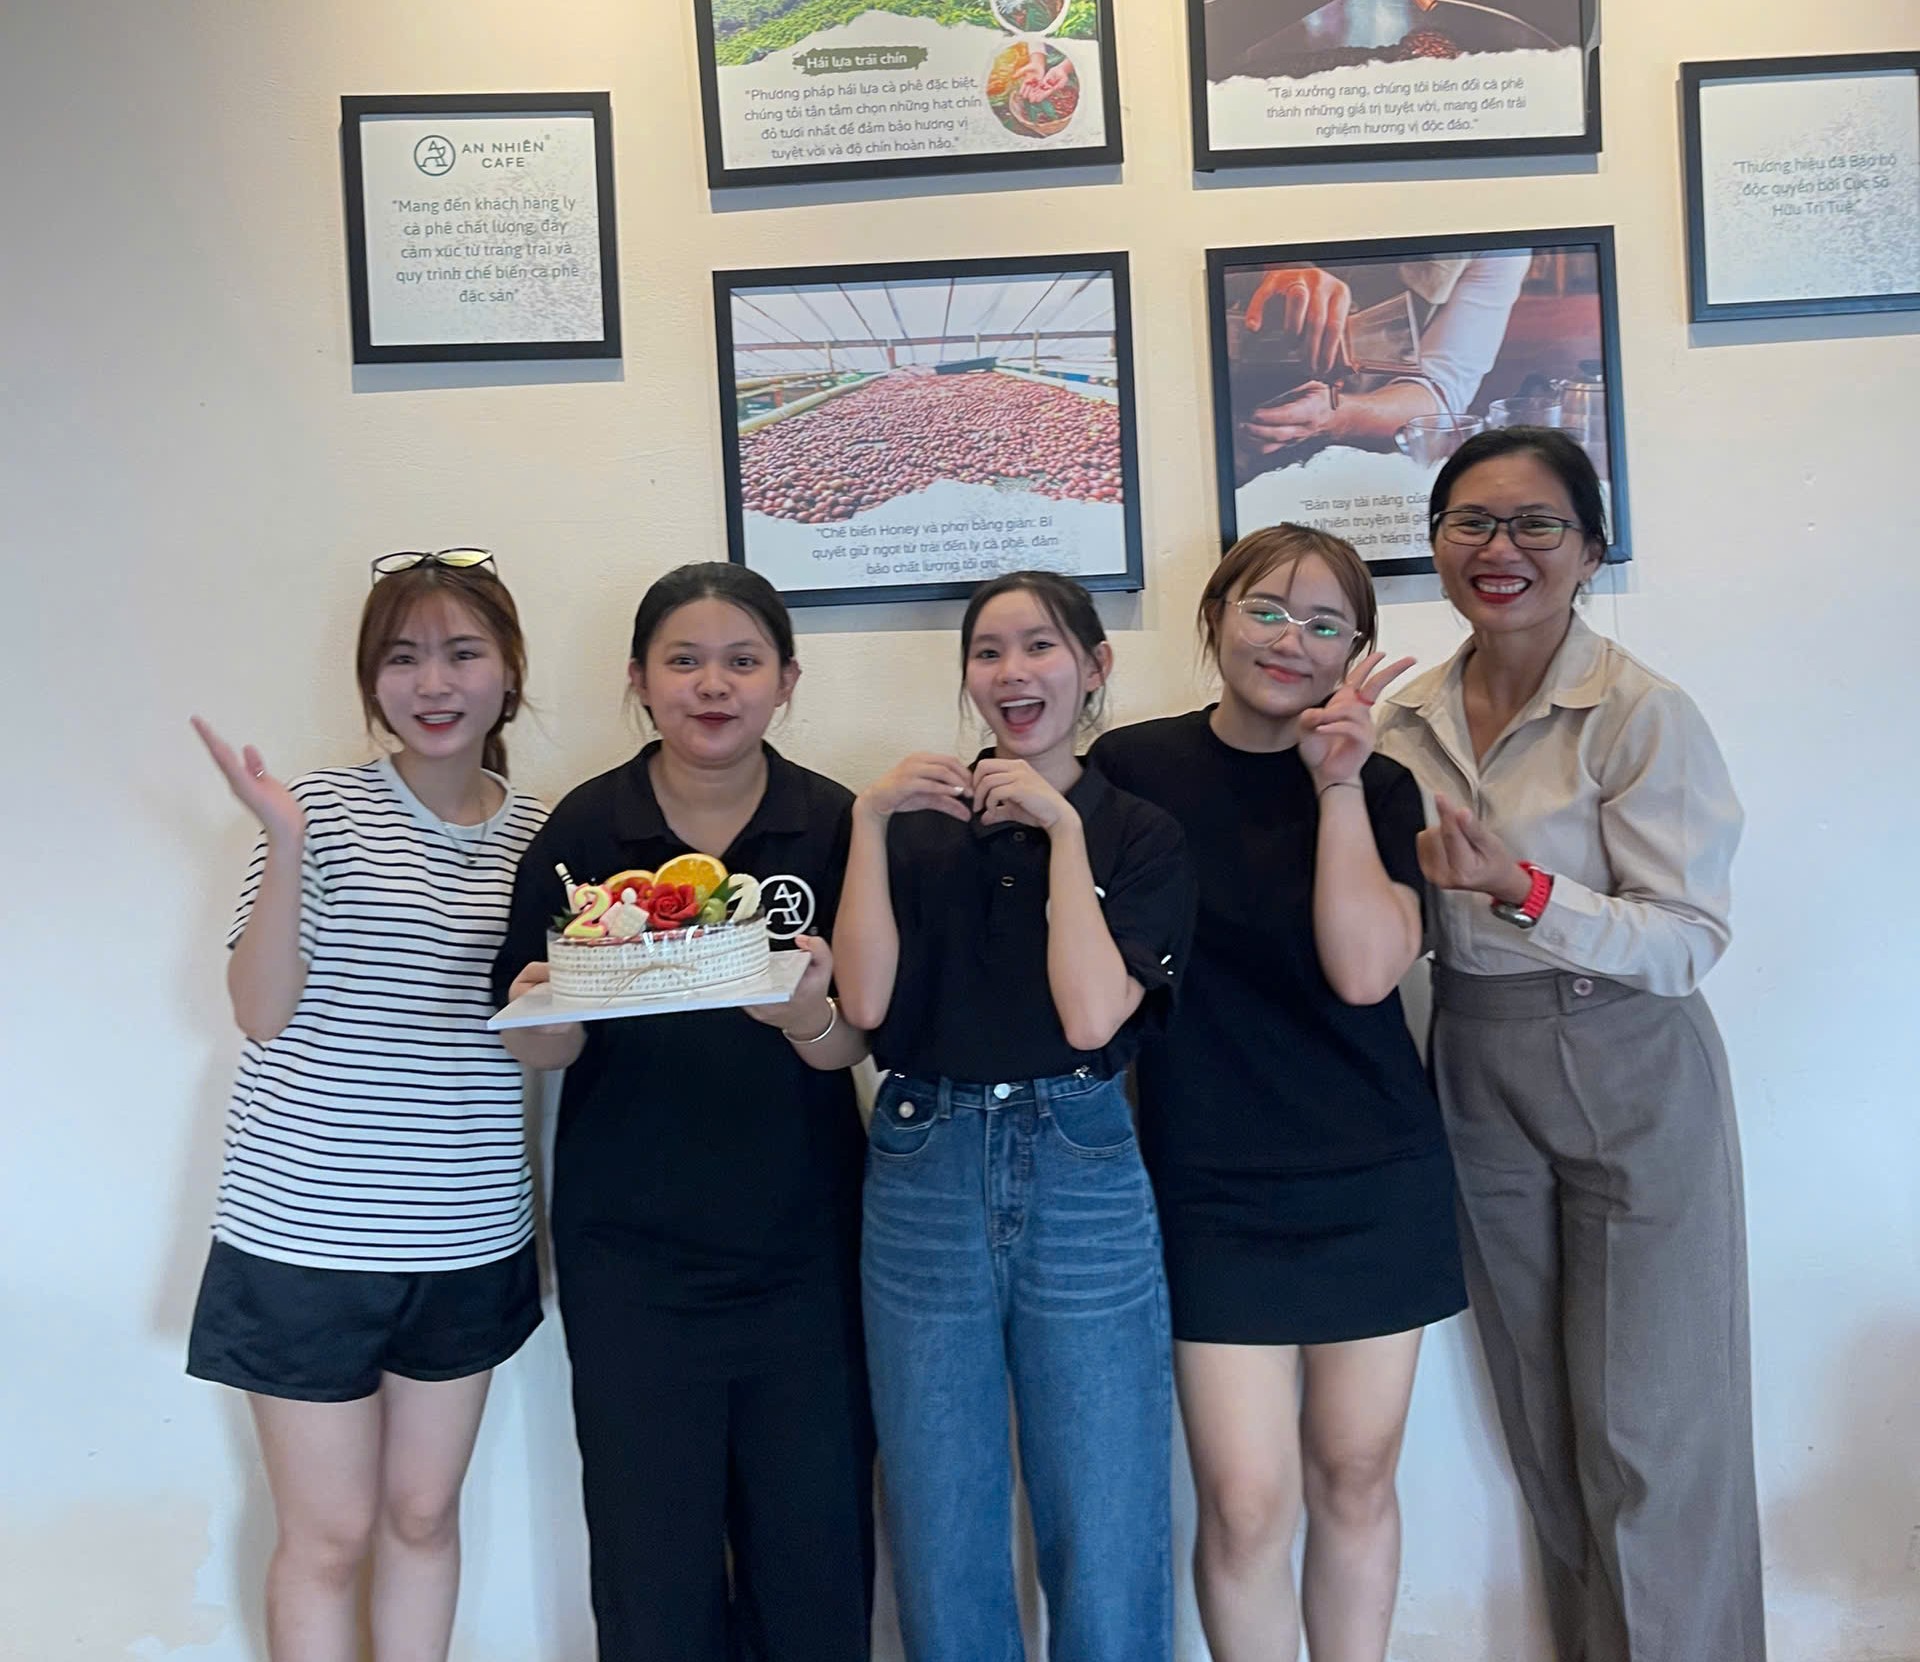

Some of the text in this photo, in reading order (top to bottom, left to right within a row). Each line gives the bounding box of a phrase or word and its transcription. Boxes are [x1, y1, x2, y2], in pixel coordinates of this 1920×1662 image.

[807, 51, 908, 70] Hái lựa trái chín
[803, 84, 835, 99] pháp
[838, 83, 857, 96] hái
[881, 81, 897, 93] cà
[899, 79, 923, 94] phê
[926, 78, 950, 90] đặc
[1373, 81, 1411, 96] chúng
[1414, 80, 1429, 93] tôi
[1432, 79, 1459, 92] biến
[1482, 78, 1498, 90] cà
[1501, 76, 1524, 93] phê
[744, 95, 982, 122] chúng tôi tận tâm chọn những hạt chín
[1266, 104, 1301, 118] thành
[1304, 104, 1345, 119] những
[1347, 102, 1366, 118] giá
[1384, 100, 1414, 117] tuyệt
[1443, 100, 1478, 113] mang
[1480, 96, 1505, 110] đến
[761, 127, 777, 140] đỏ
[780, 127, 804, 139] tươi
[807, 123, 837, 137] nhất
[857, 121, 885, 134] đảm
[888, 119, 912, 132] bảo
[915, 119, 954, 132] hương
[957, 116, 968, 131] vị
[1315, 122, 1361, 138] nghiệm
[1364, 121, 1405, 135] hương
[1408, 120, 1419, 135] vị
[1421, 119, 1444, 133] độc
[461, 143, 485, 154] AN
[771, 145, 804, 160] tuyệt
[807, 144, 825, 156] vời
[828, 143, 843, 155] và
[846, 142, 862, 156] độ
[865, 141, 892, 153] chín
[895, 139, 925, 151] hoàn
[481, 157, 525, 169] CAFE
[443, 196, 471, 212] đến
[475, 196, 518, 212] khách
[523, 195, 559, 213] hàng
[563, 195, 576, 212] ly
[403, 222, 421, 236] cà
[425, 219, 452, 238] phê
[456, 219, 489, 234] chất
[401, 243, 432, 259] cảm
[436, 244, 461, 258] xúc
[484, 244, 522, 260] trang
[555, 242, 572, 255] và
[396, 270, 423, 285] quy
[427, 267, 461, 281] trình
[465, 265, 491, 280] chế
[496, 264, 527, 279] biến
[552, 263, 580, 280] phê
[880, 524, 920, 537] Honey
[922, 521, 939, 534] và
[812, 544, 847, 560] quyết
[969, 538, 980, 553] ly
